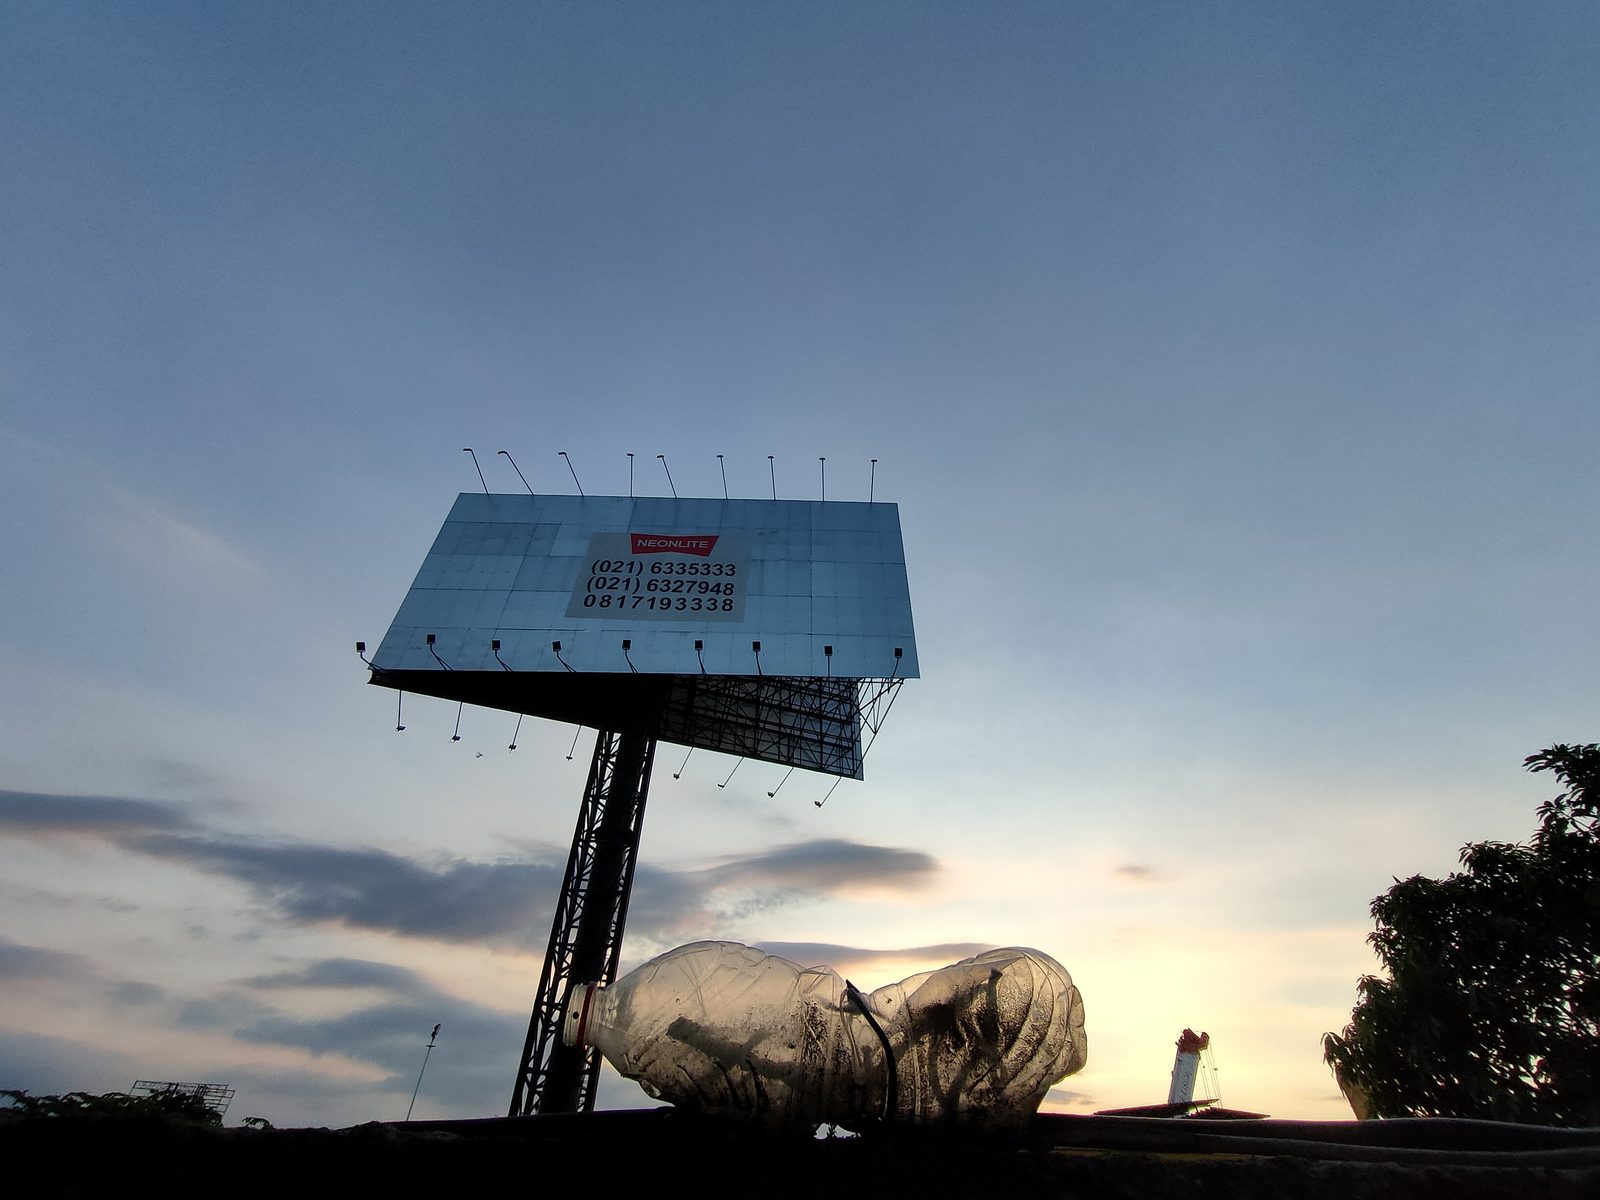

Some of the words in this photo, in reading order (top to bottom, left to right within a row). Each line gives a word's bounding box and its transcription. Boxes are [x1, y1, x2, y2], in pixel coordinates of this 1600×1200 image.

[637, 539, 708, 549] NEONLITE
[591, 560, 644, 576] (021)
[650, 561, 736, 576] 6335333
[587, 576, 640, 594] (021)
[647, 579, 735, 596] 6327948
[583, 594, 734, 612] 0817193338
